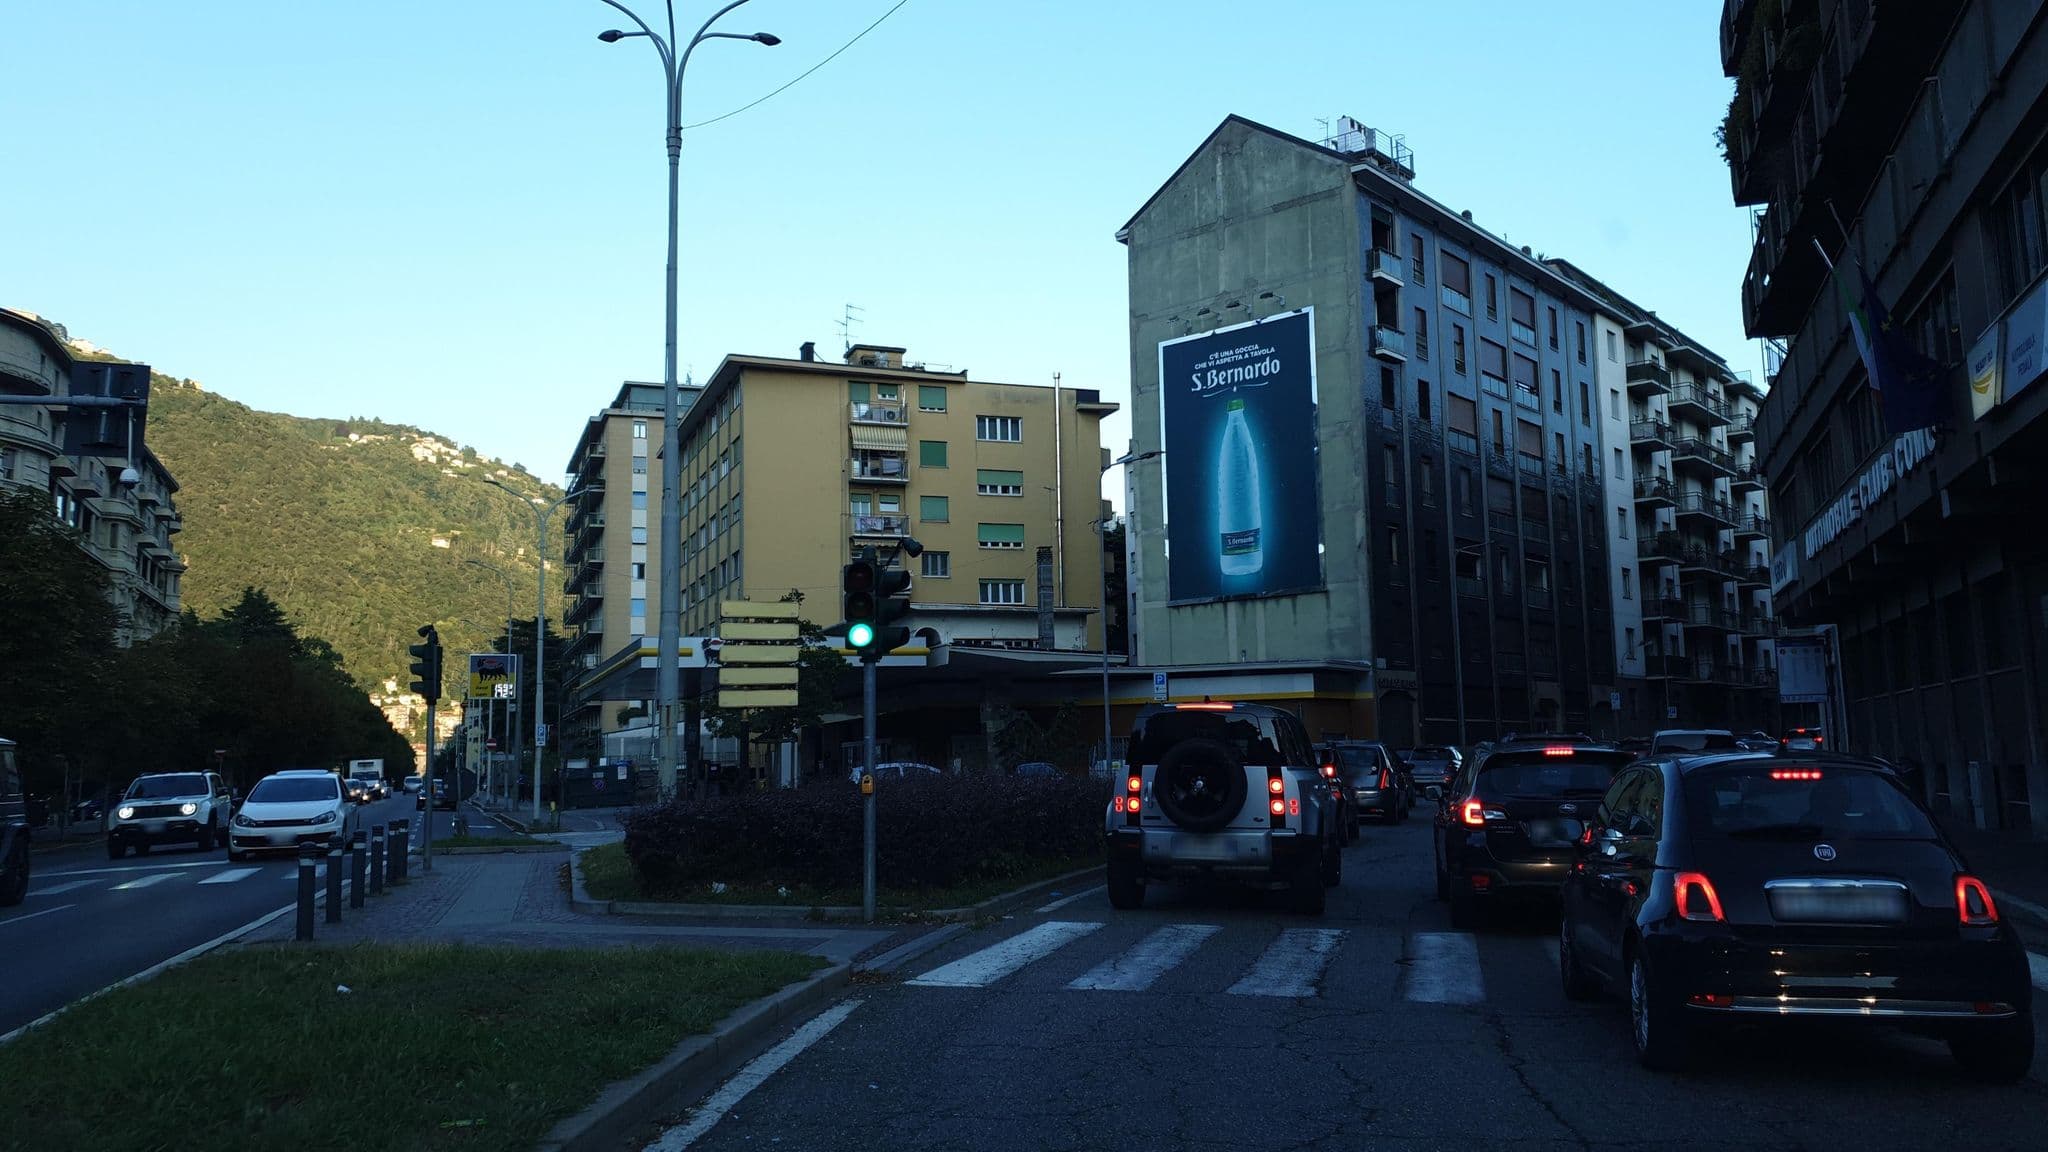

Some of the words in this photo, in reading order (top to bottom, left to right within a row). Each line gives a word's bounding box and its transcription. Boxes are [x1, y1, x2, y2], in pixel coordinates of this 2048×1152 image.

[1194, 362, 1207, 370] CHE
[1215, 355, 1242, 365] ASPETTA
[1250, 347, 1275, 356] TAVOLA
[1235, 344, 1259, 353] GOCCIA
[1805, 487, 1861, 560] AUTOMOBILE
[1859, 452, 1895, 511] CLUB
